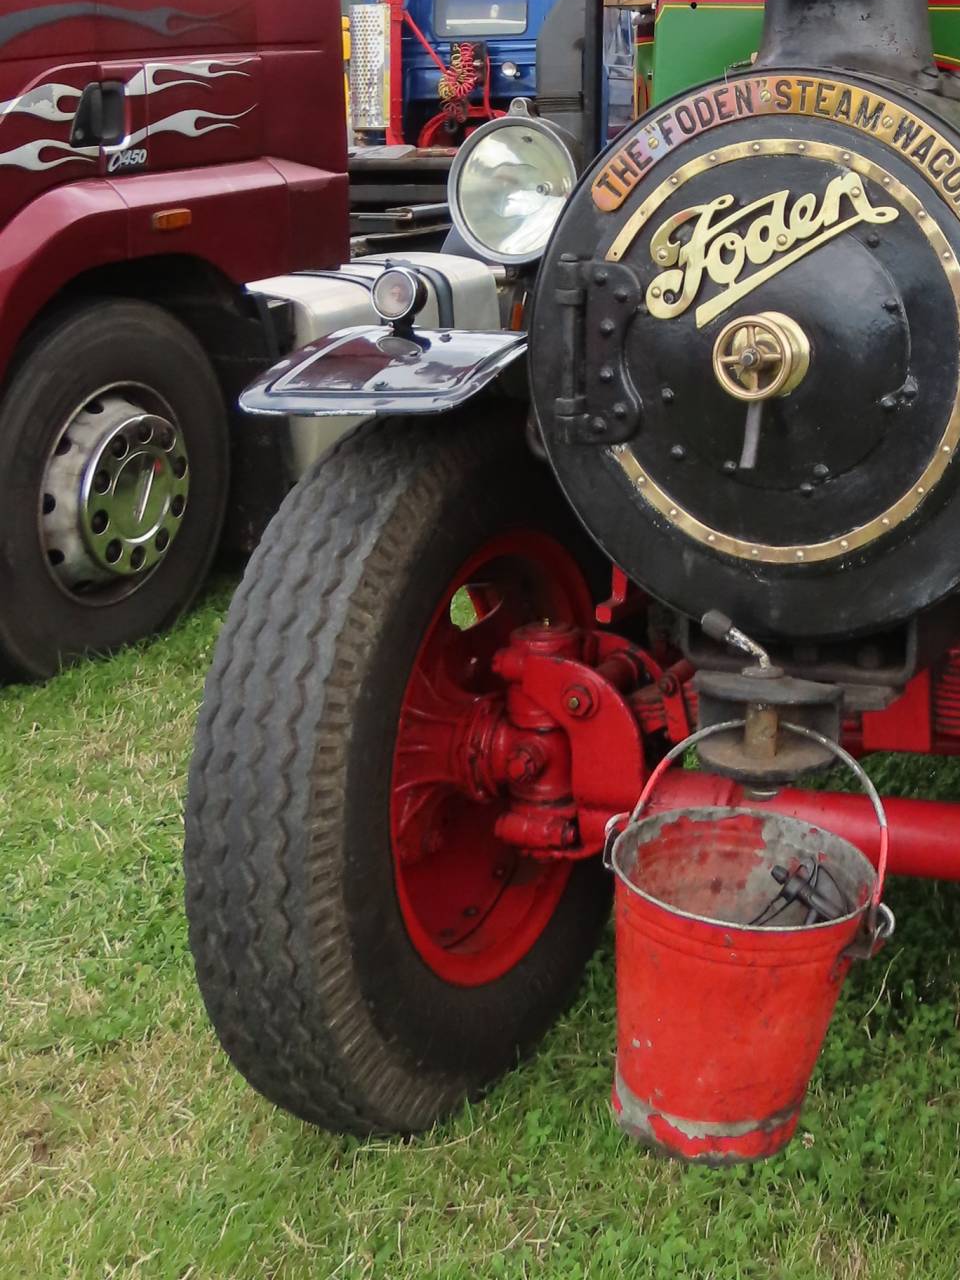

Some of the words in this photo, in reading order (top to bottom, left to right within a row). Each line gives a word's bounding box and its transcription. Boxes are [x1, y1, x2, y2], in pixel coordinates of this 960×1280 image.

[596, 138, 654, 199] THE
[774, 78, 887, 132] STEAM
[646, 171, 899, 329] Foden
